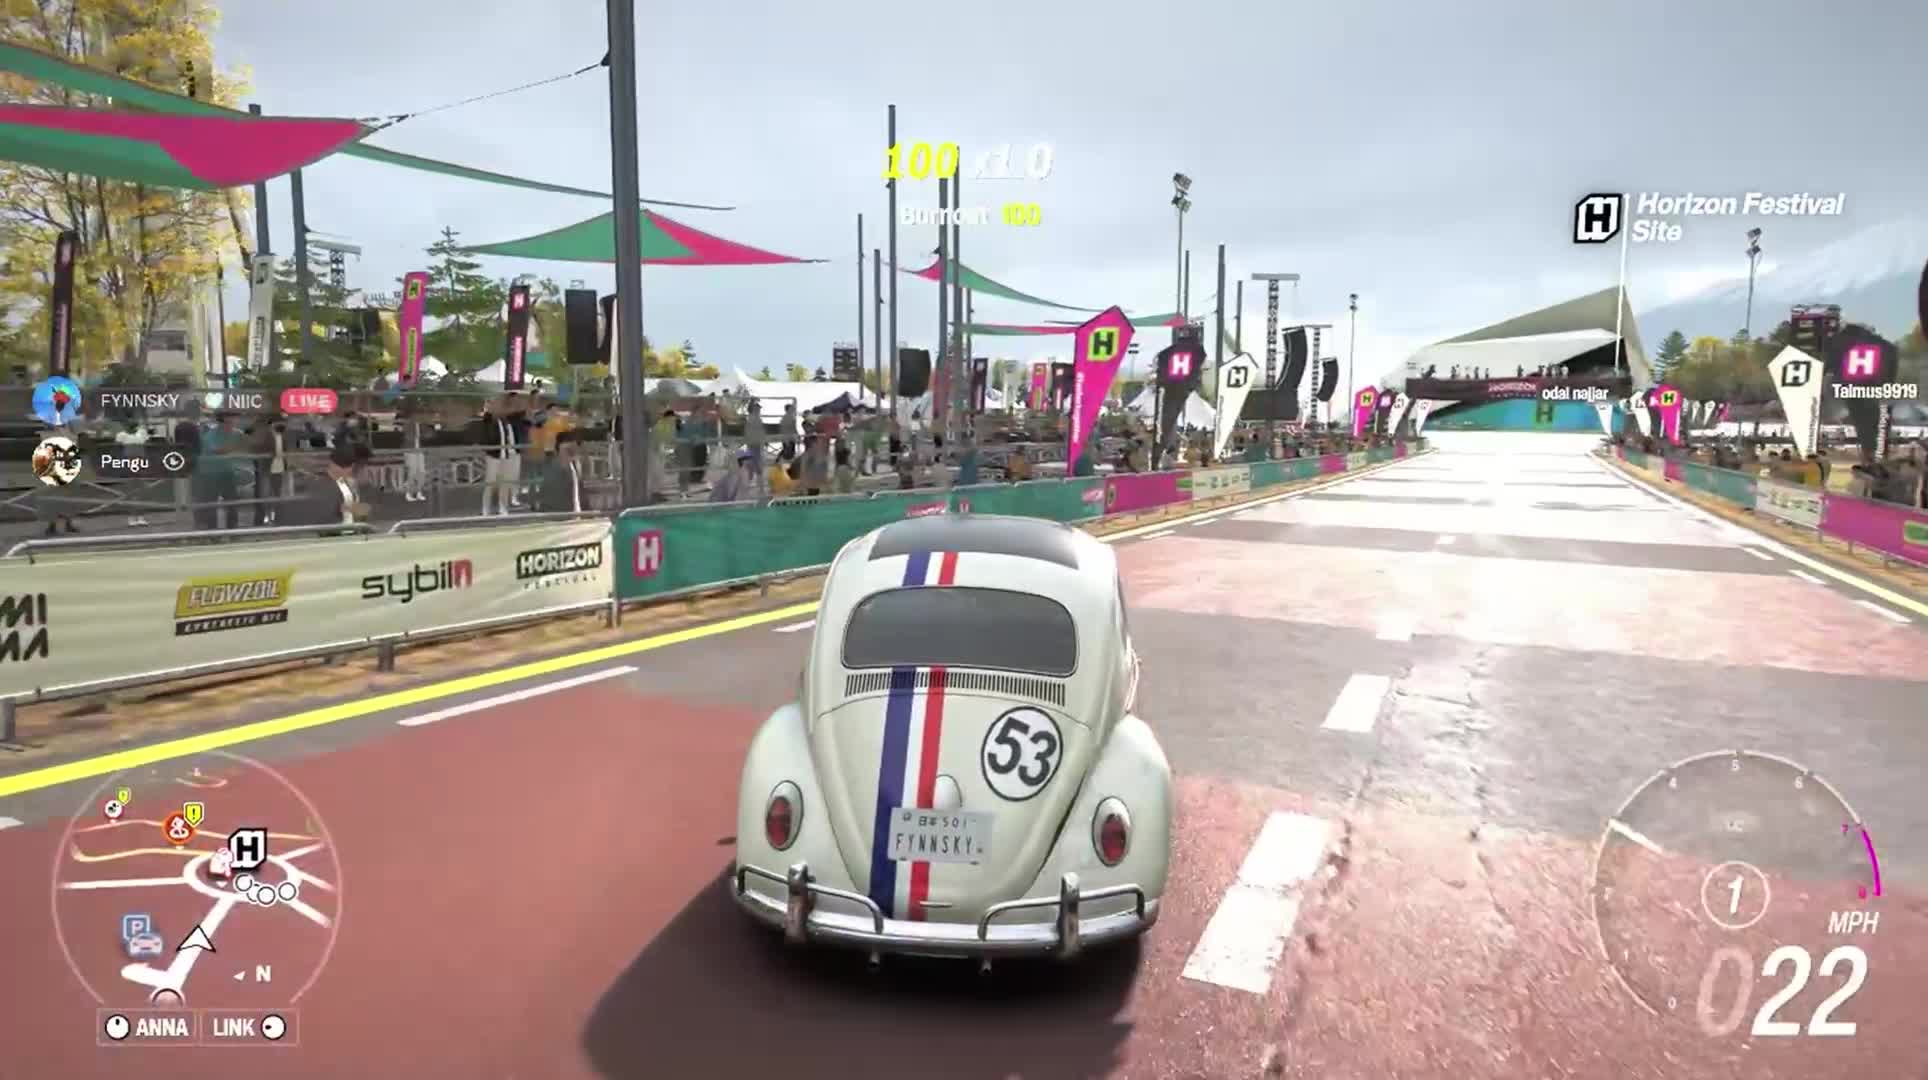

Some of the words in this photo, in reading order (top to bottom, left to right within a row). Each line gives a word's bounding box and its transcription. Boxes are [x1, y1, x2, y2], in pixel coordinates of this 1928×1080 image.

[519, 546, 601, 577] HORIZON
[988, 716, 1057, 787] 53
[896, 833, 972, 854] FYNNSKY
